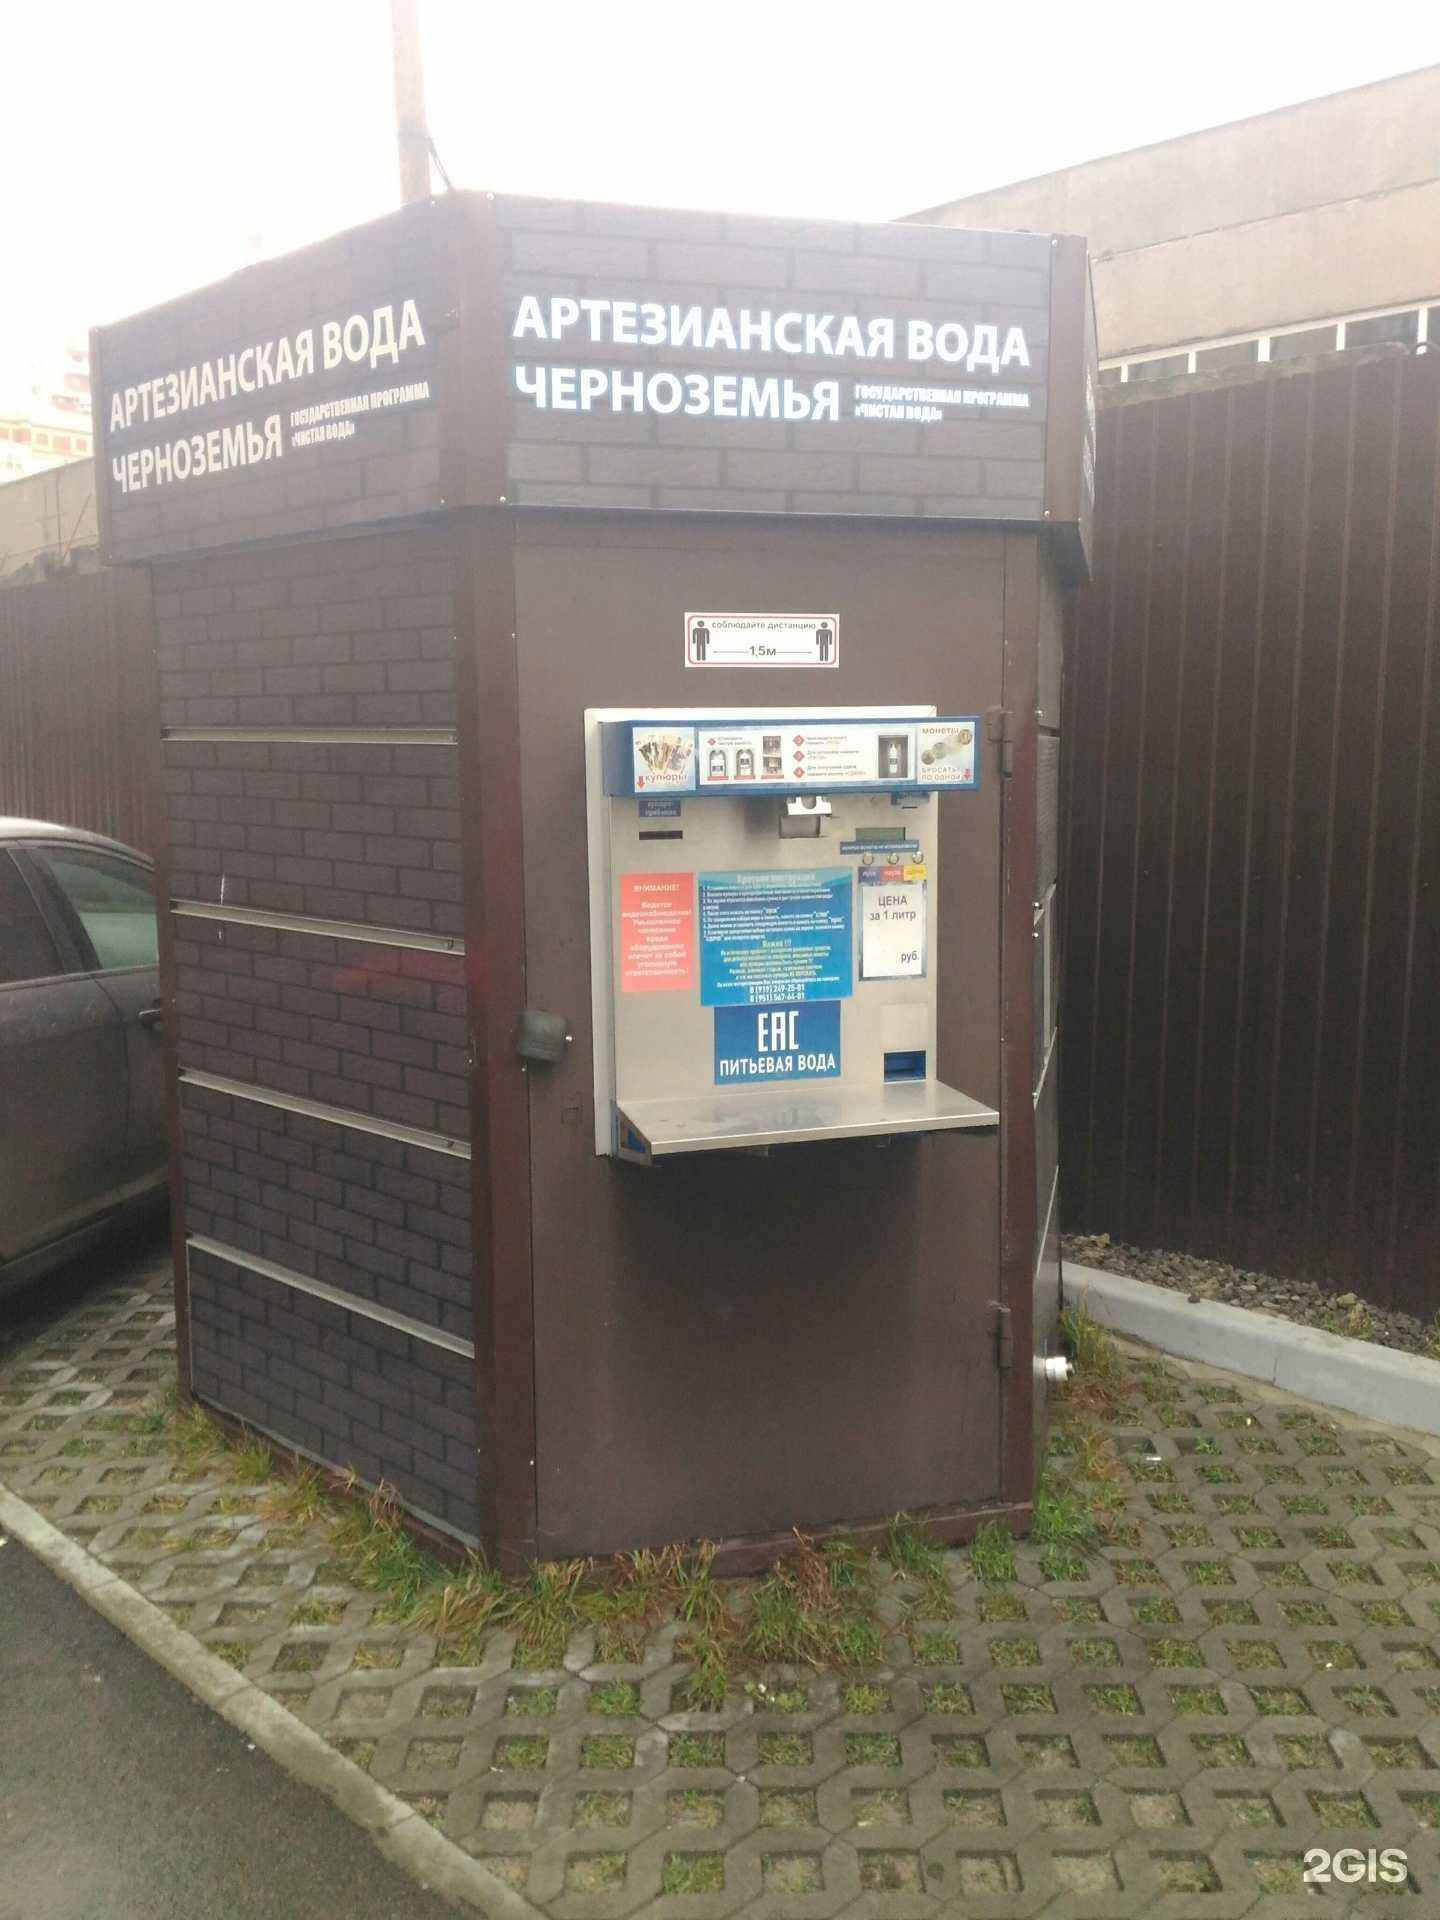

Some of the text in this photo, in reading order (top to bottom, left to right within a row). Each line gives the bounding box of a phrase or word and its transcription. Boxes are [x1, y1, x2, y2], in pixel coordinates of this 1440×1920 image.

[512, 295, 1031, 373] АРТЕЗИАНСКАЯ ВОДА
[110, 299, 426, 432] АРТЕЗИАНСКАЯ ВОДА
[514, 364, 840, 422] ЧЕРНОЗЕМЬЯ
[112, 414, 282, 493] ЧЕРНОЗЕМЬЯ
[712, 620, 816, 631] соблюдайте дистанцию
[878, 895, 907, 908] ЦЕНА
[884, 910, 888, 920] 1
[891, 911, 916, 921] литр
[901, 950, 920, 963] руб.
[720, 1053, 836, 1077] ПИТЬЕВАЯ ВОДА
